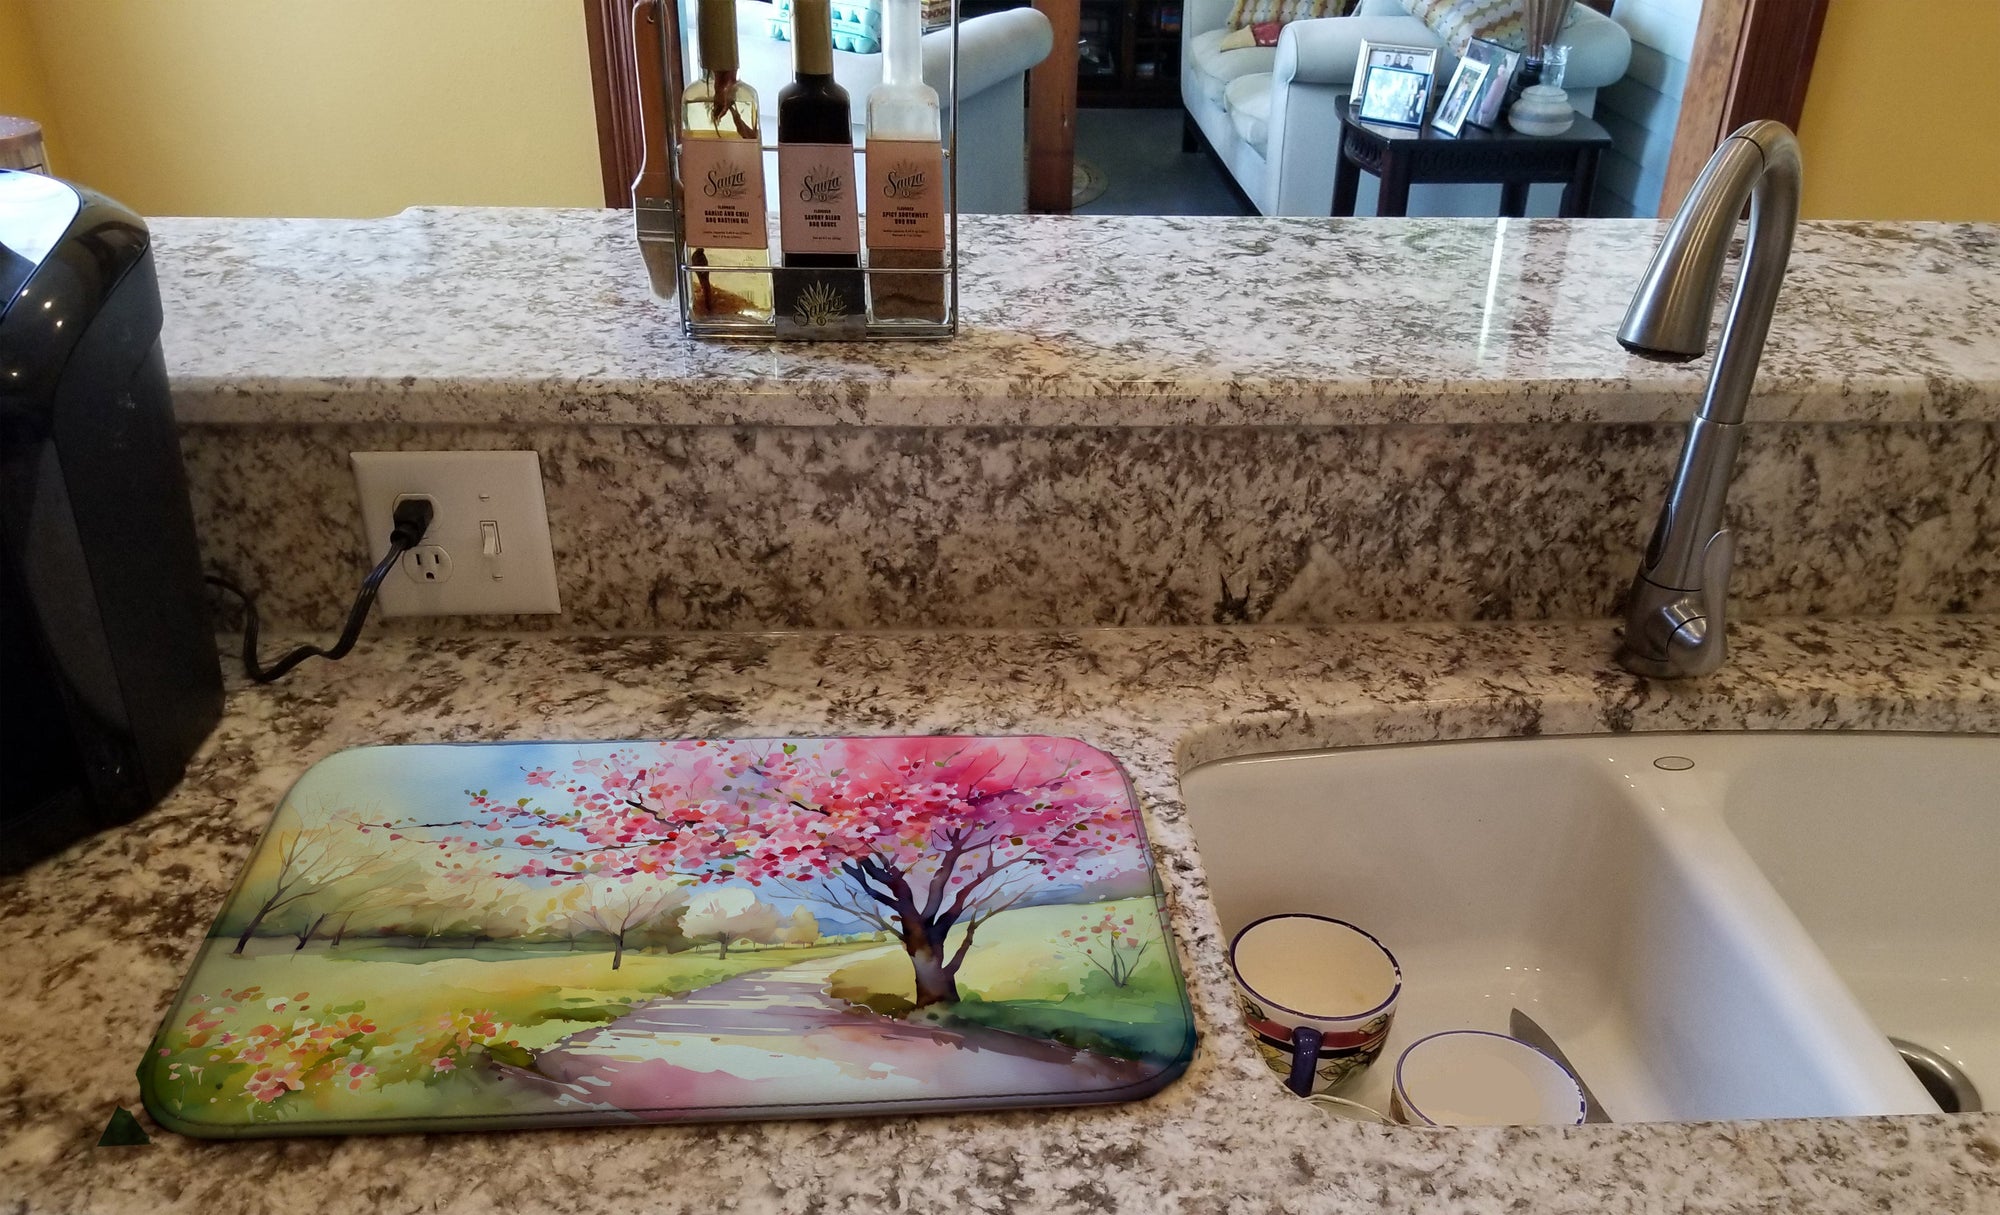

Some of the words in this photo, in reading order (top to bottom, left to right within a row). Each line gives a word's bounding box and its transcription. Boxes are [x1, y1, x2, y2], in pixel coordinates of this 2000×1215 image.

[704, 170, 746, 197] Sauza
[800, 175, 842, 202] Sauza
[883, 171, 926, 198] Sauza
[793, 296, 844, 327] Sauza
